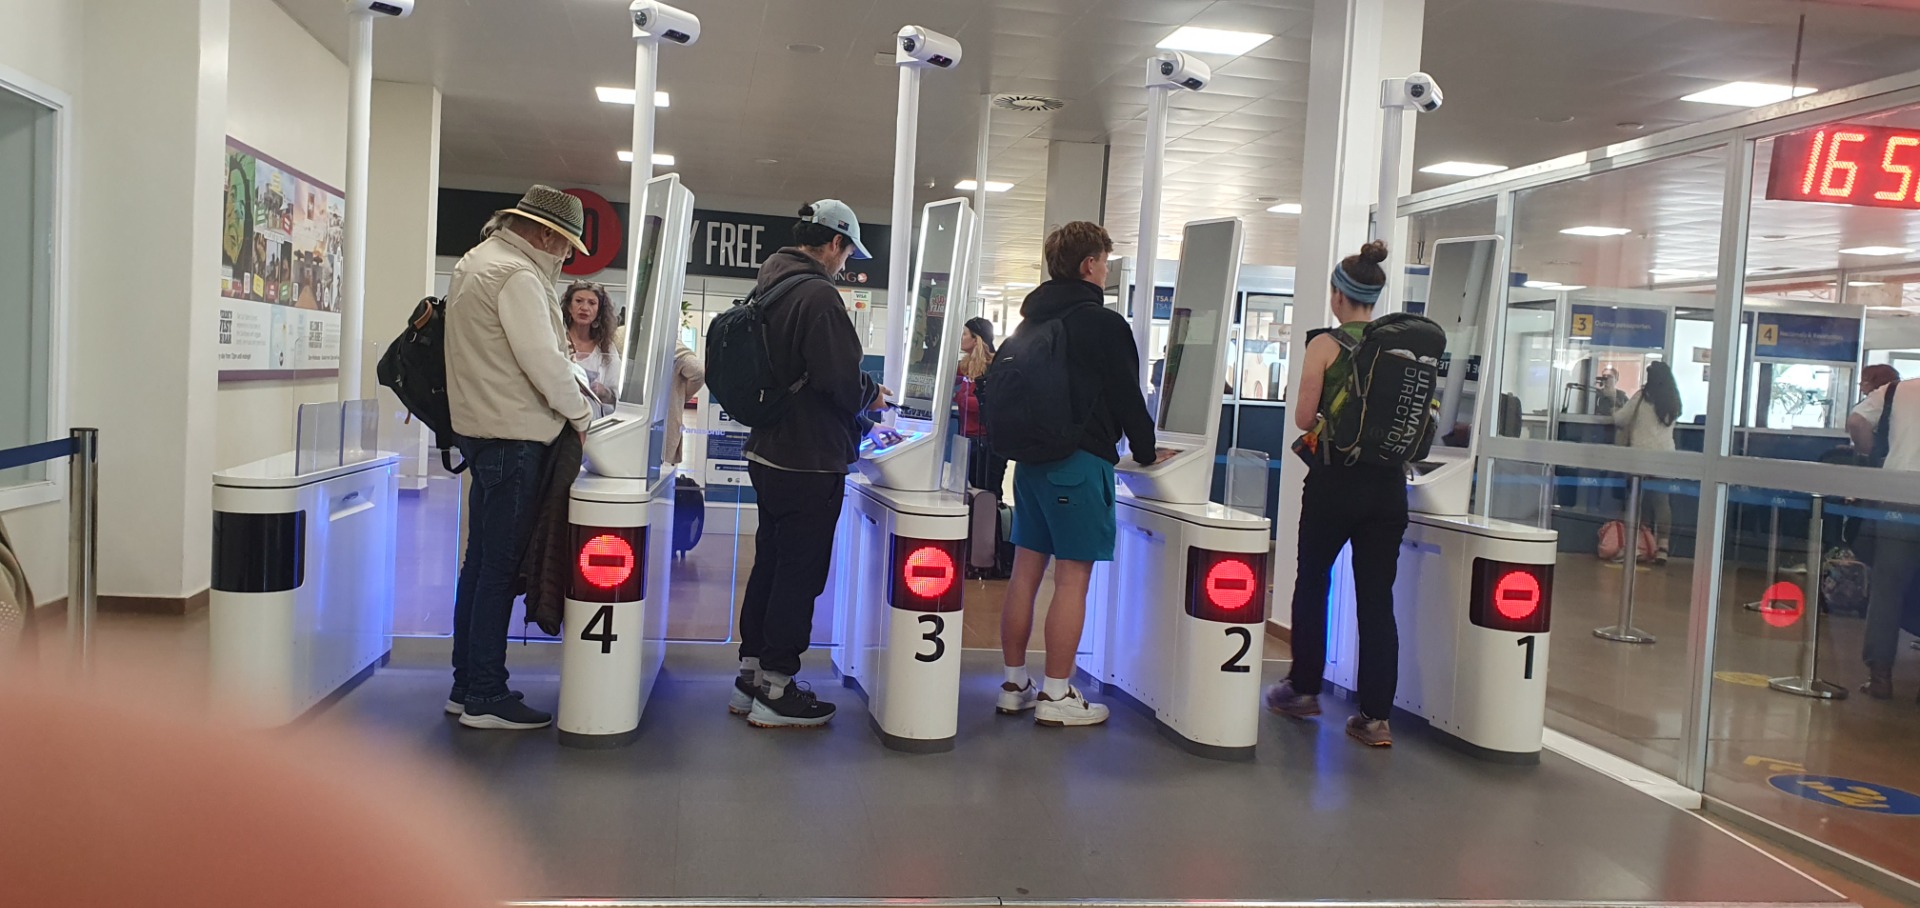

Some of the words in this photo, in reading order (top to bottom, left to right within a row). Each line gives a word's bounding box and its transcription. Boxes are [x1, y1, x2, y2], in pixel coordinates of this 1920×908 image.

[1802, 130, 1866, 197] 16
[1874, 136, 1920, 202] 5
[706, 221, 765, 268] FREE
[1577, 317, 1587, 331] 3
[1763, 327, 1773, 341] 4
[679, 424, 726, 436] Panasonic
[1391, 370, 1430, 455] ULTIMATE
[580, 605, 617, 654] 4
[914, 614, 945, 662] 3
[1220, 627, 1252, 673] 2
[1517, 635, 1535, 680] 1
